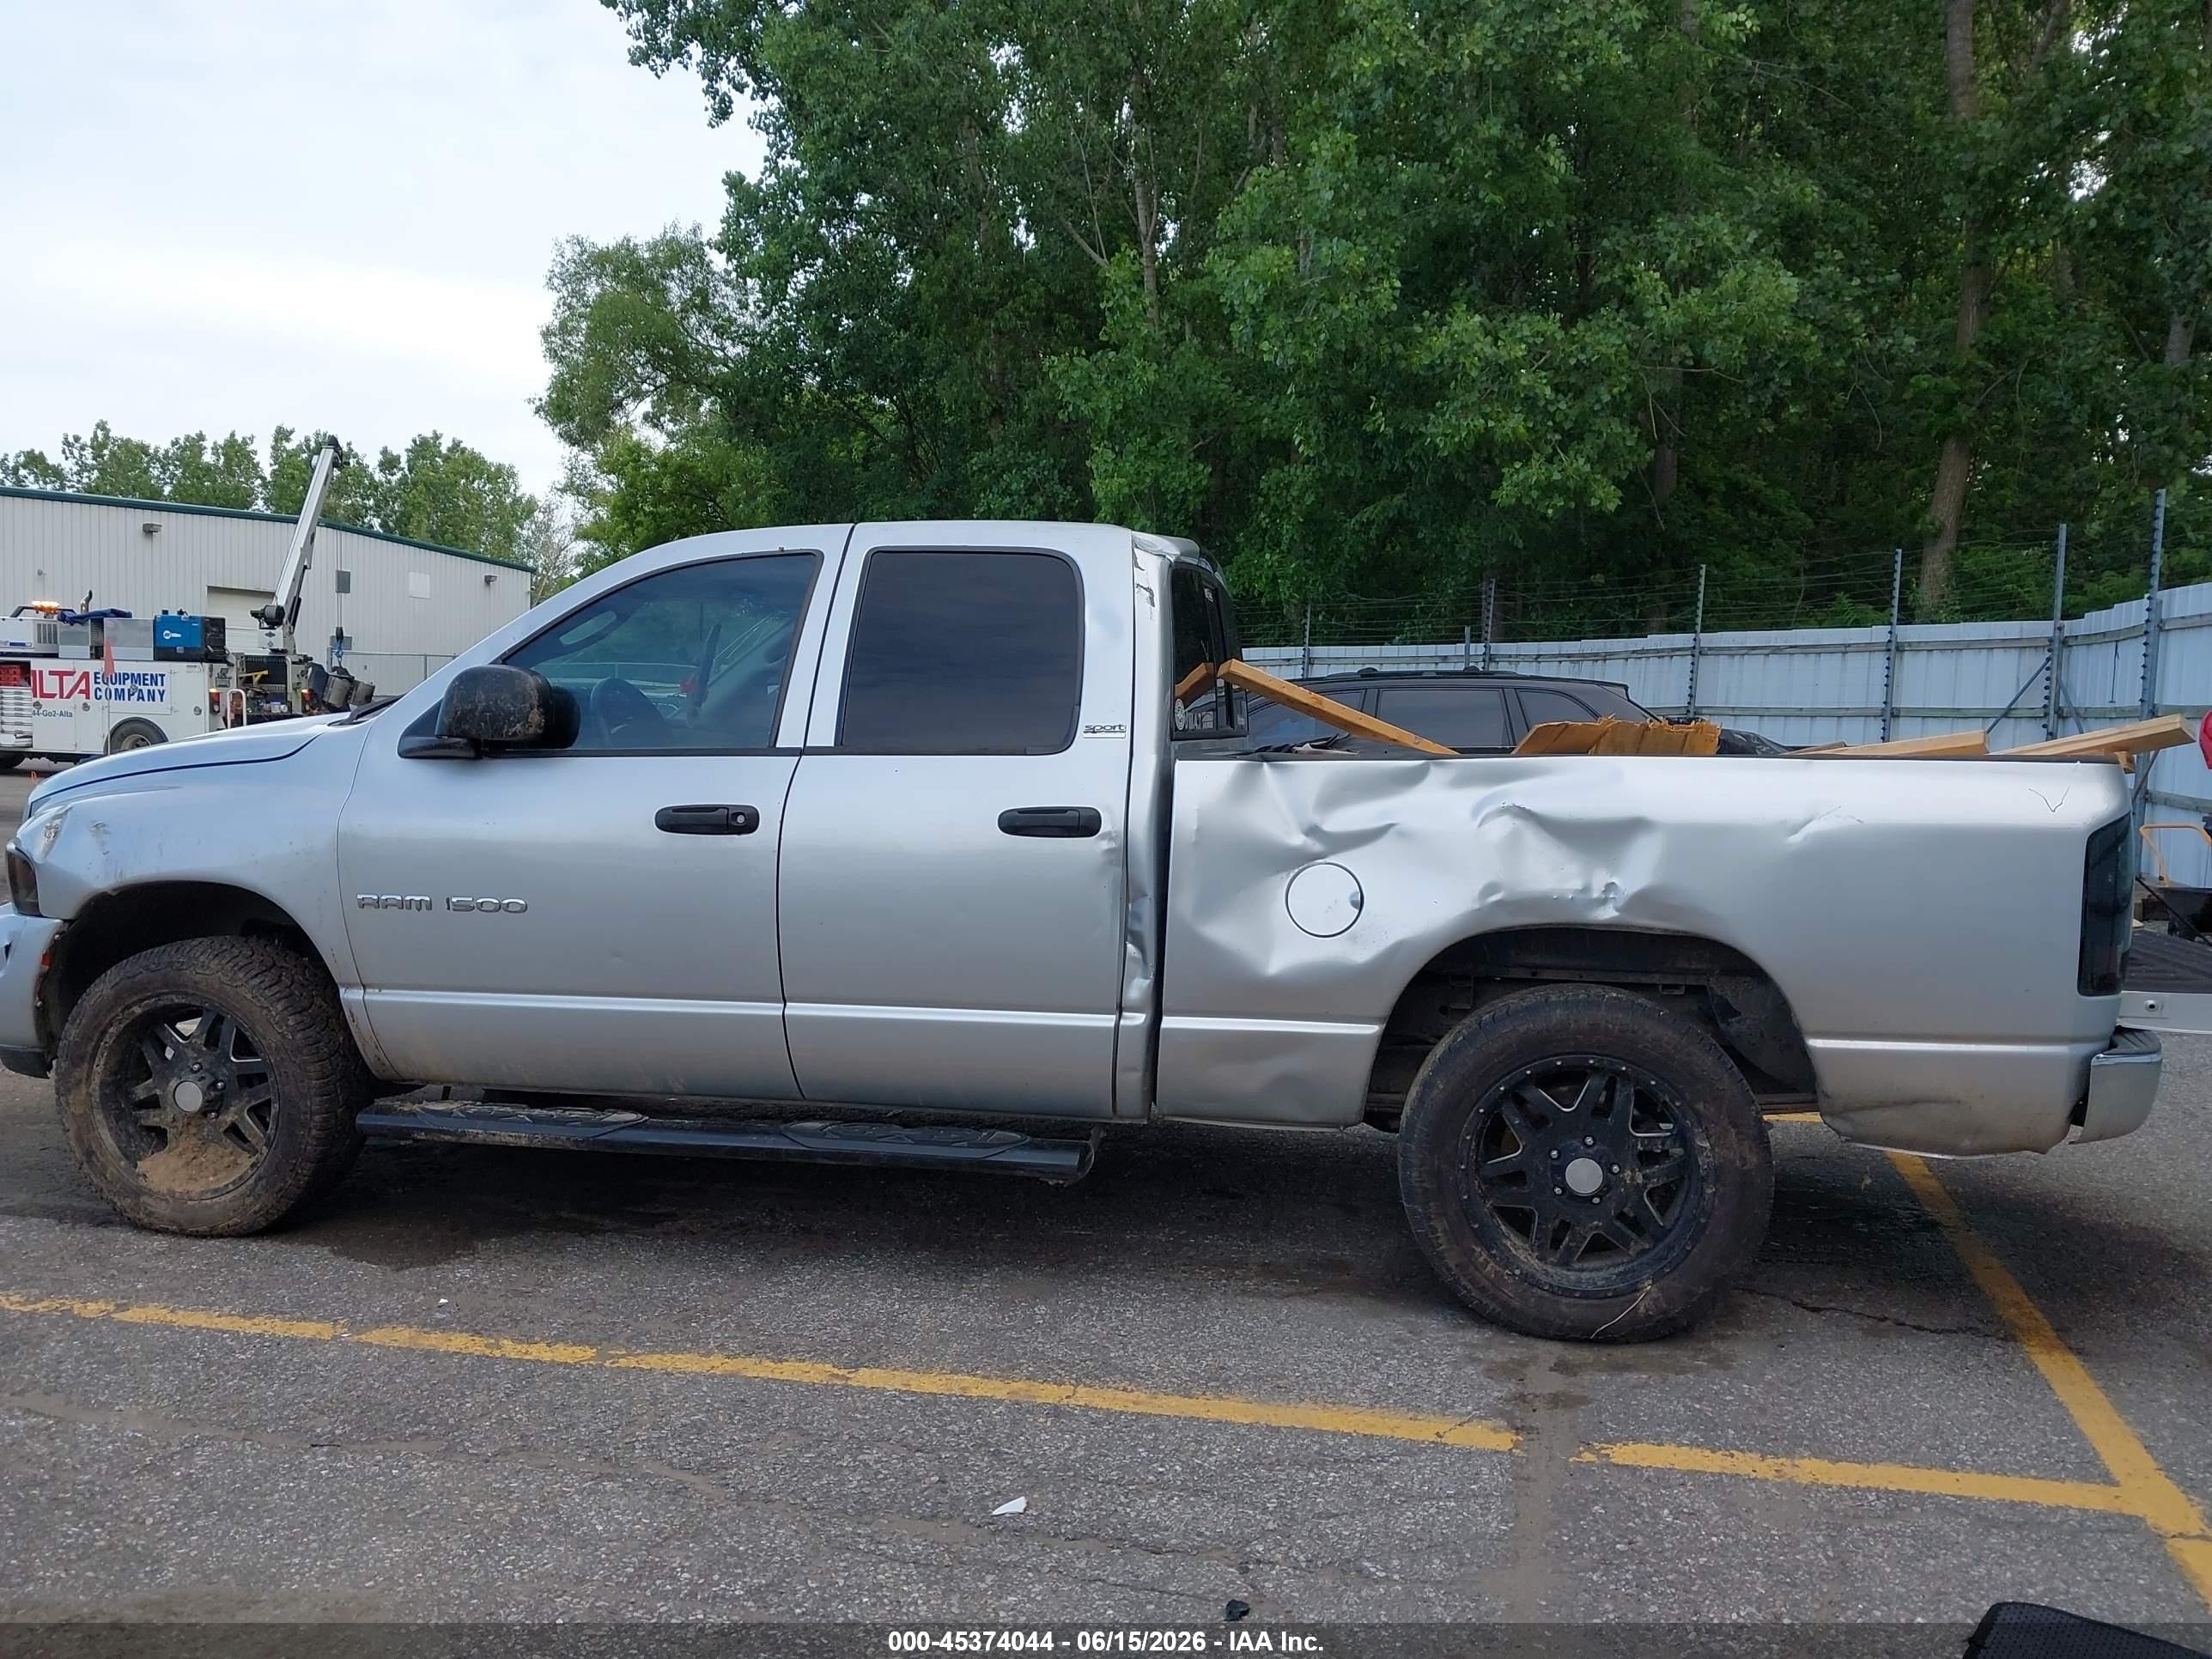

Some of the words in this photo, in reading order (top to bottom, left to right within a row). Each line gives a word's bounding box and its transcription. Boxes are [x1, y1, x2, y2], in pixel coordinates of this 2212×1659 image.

[94, 672, 166, 687] EQUIPMENT
[94, 687, 166, 702] COMPANY
[1085, 724, 1127, 734] sport
[356, 893, 433, 912] RAM
[446, 896, 528, 914] 1500
